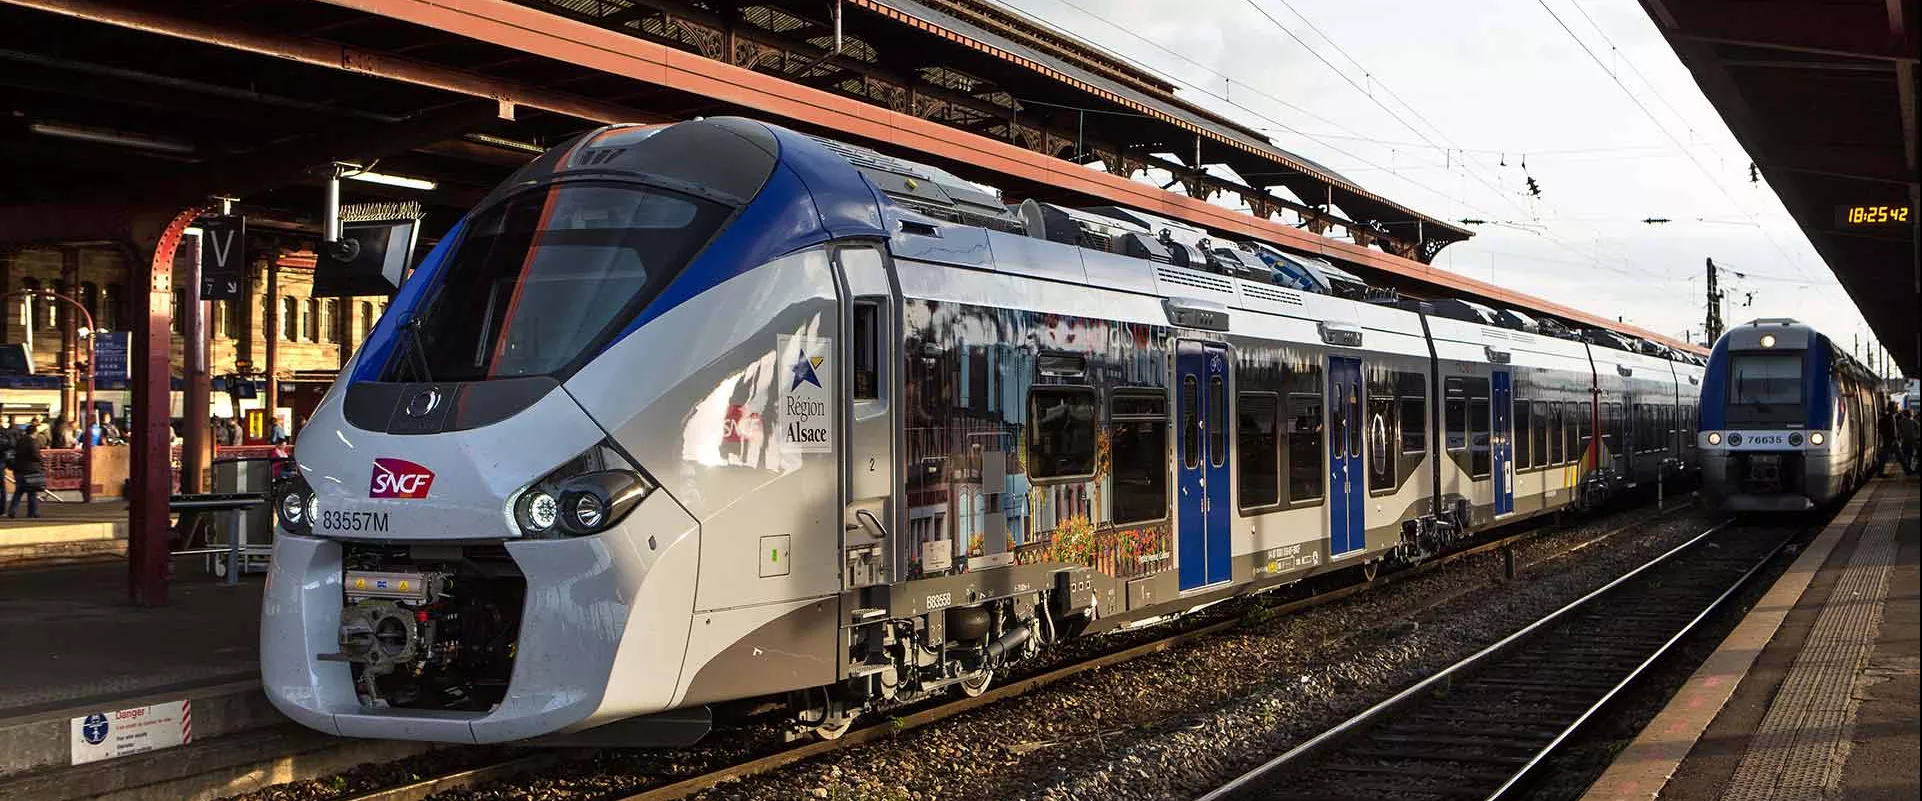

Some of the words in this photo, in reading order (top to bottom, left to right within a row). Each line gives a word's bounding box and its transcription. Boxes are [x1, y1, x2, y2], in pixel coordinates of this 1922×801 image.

[1848, 206, 1888, 223] 18:25
[1890, 208, 1908, 221] 42
[210, 229, 234, 267] V
[787, 396, 825, 422] Région
[786, 421, 827, 442] Alsace
[1748, 436, 1782, 444] 76635
[869, 457, 875, 472] 2
[371, 473, 430, 494] SNCF
[323, 510, 389, 532] 83557M
[115, 709, 145, 720] Danger
